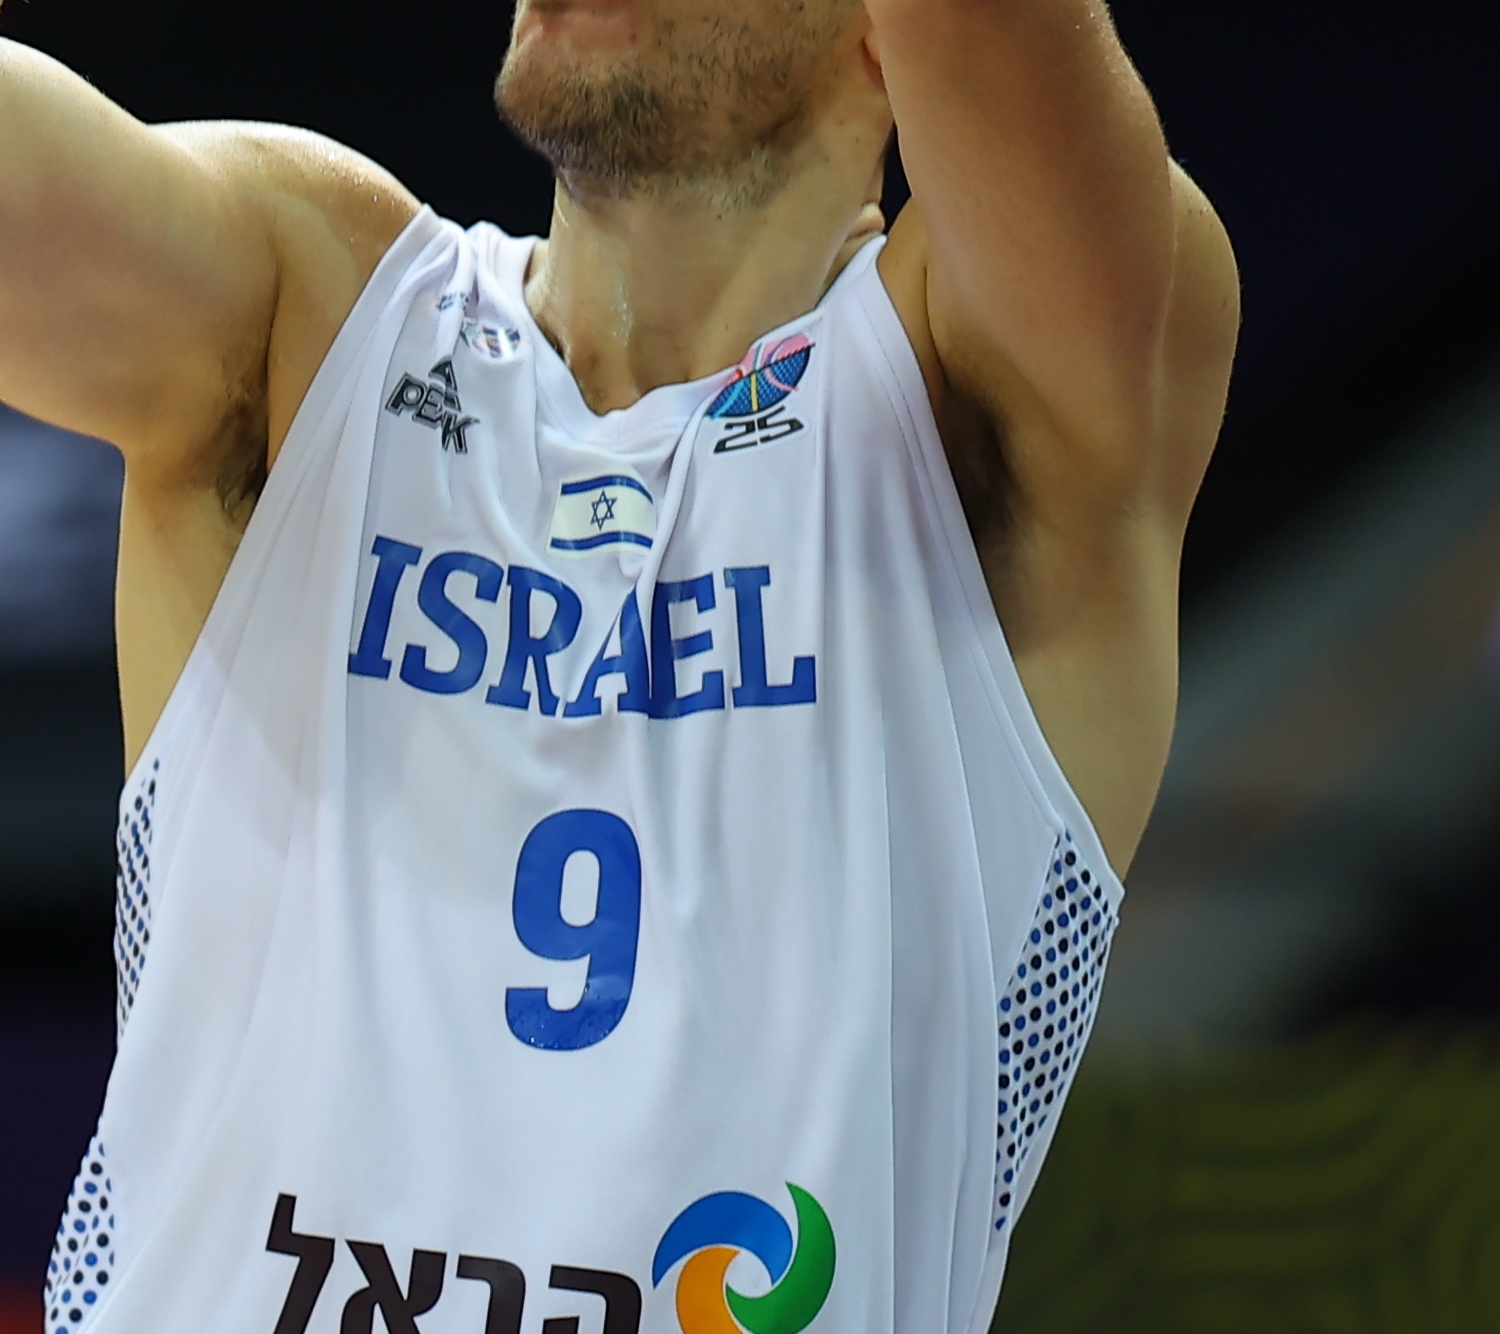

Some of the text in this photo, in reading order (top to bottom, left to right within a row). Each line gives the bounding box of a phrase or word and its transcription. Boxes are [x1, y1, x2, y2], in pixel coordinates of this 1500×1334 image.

[713, 405, 804, 454] 25
[347, 535, 817, 720] ISRAEL
[505, 808, 642, 1051] 9
